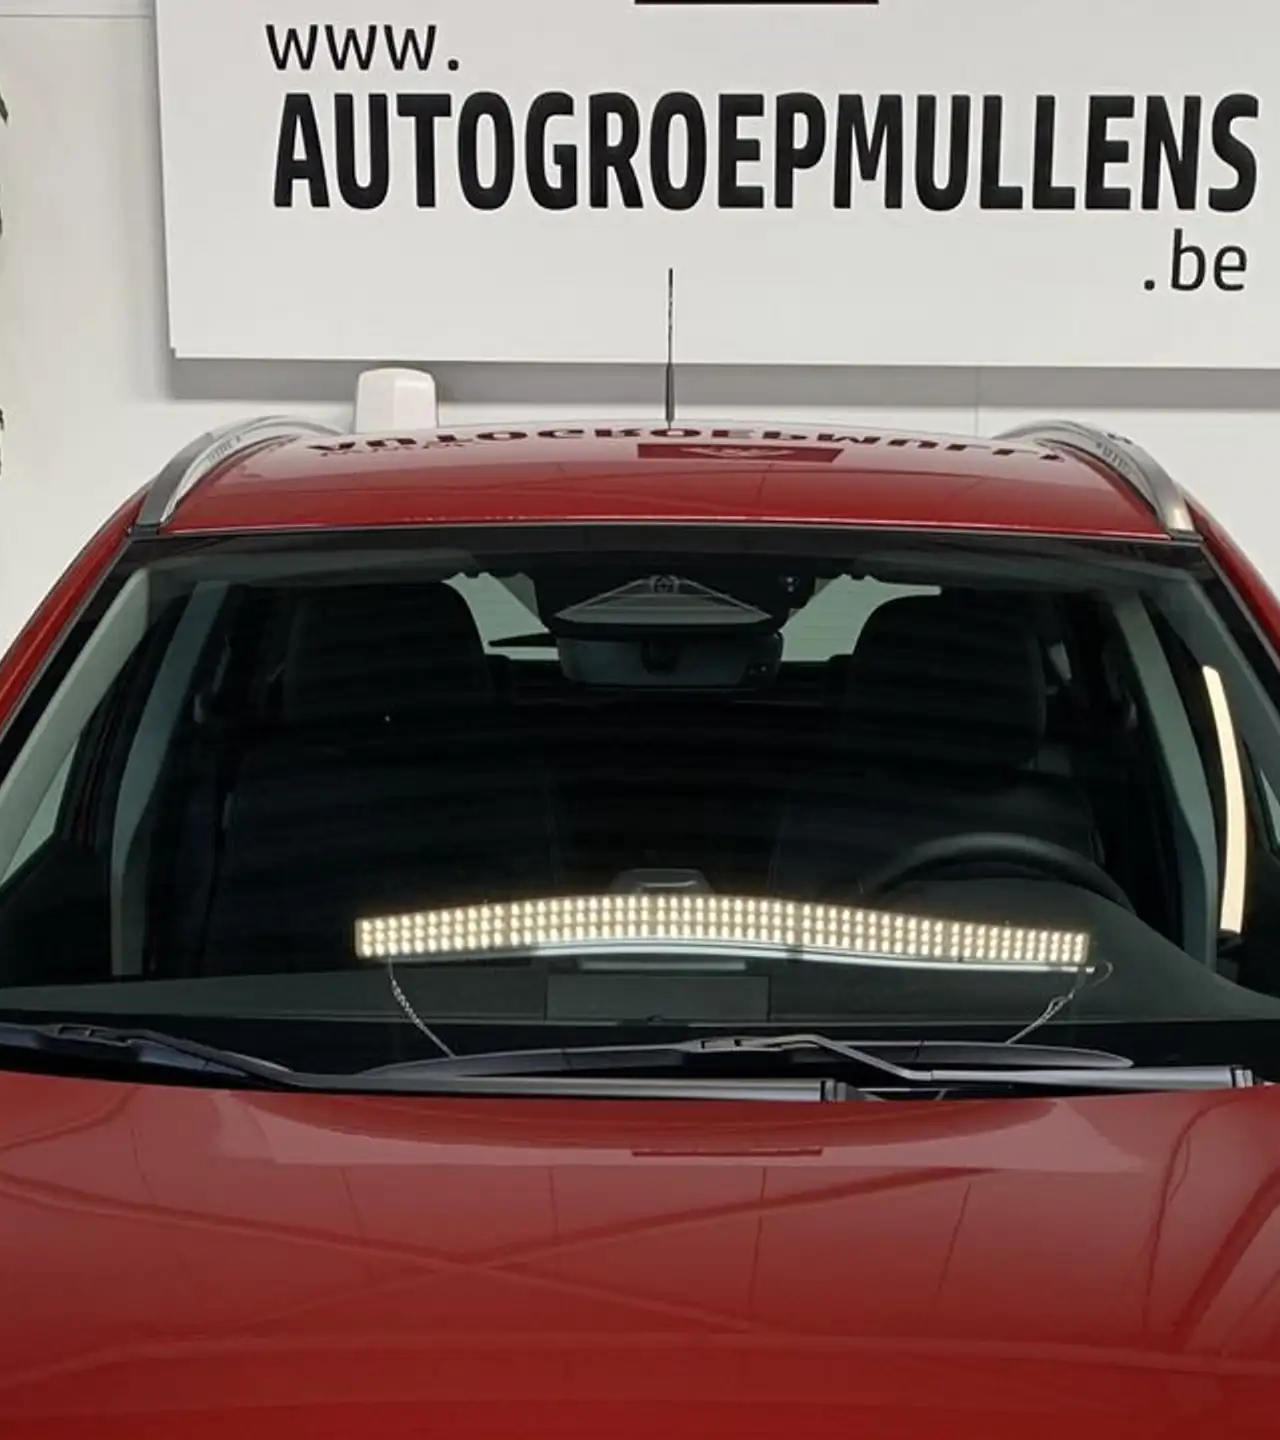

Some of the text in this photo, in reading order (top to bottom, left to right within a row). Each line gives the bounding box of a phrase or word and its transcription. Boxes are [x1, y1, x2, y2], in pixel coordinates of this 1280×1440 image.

[265, 24, 459, 71] www.
[273, 91, 1259, 213] AUTOGROEPMULLENS
[1144, 228, 1247, 292] .be
